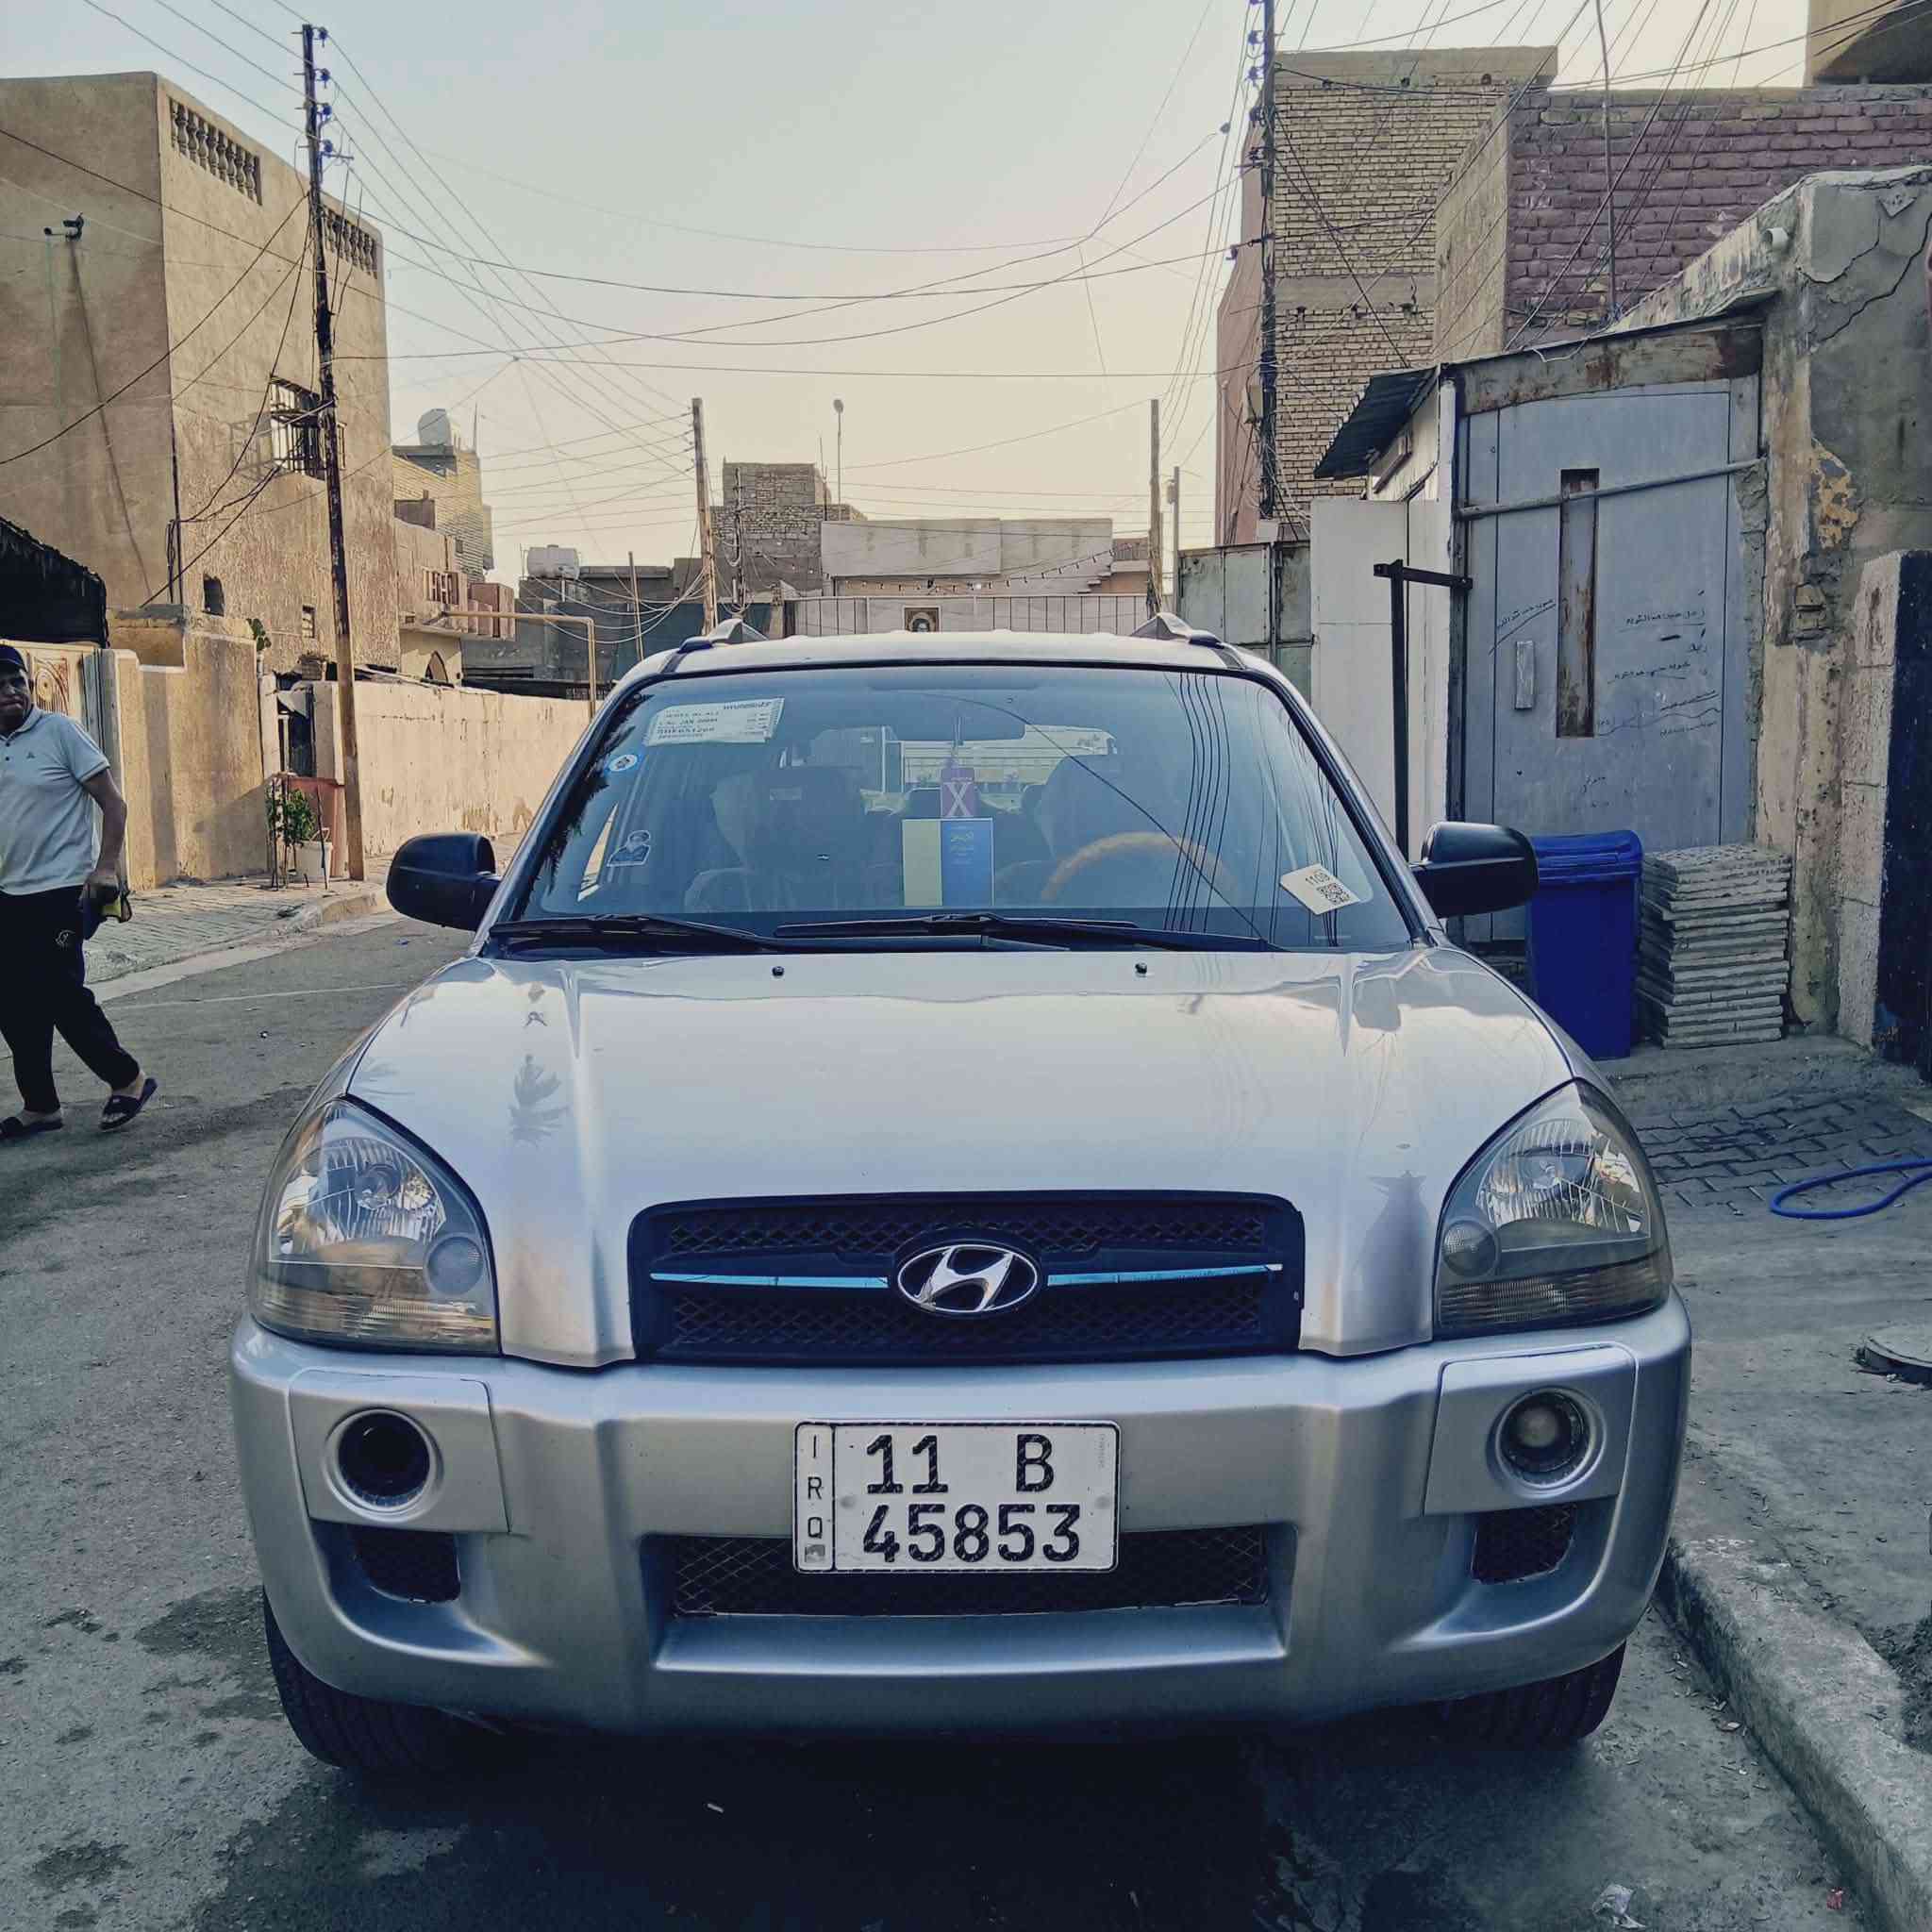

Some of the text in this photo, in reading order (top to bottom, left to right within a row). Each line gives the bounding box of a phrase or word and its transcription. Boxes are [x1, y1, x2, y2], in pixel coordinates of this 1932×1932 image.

[866, 1434, 949, 1494] 11
[1015, 1433, 1055, 1492] B
[862, 1504, 1081, 1563] 45853
